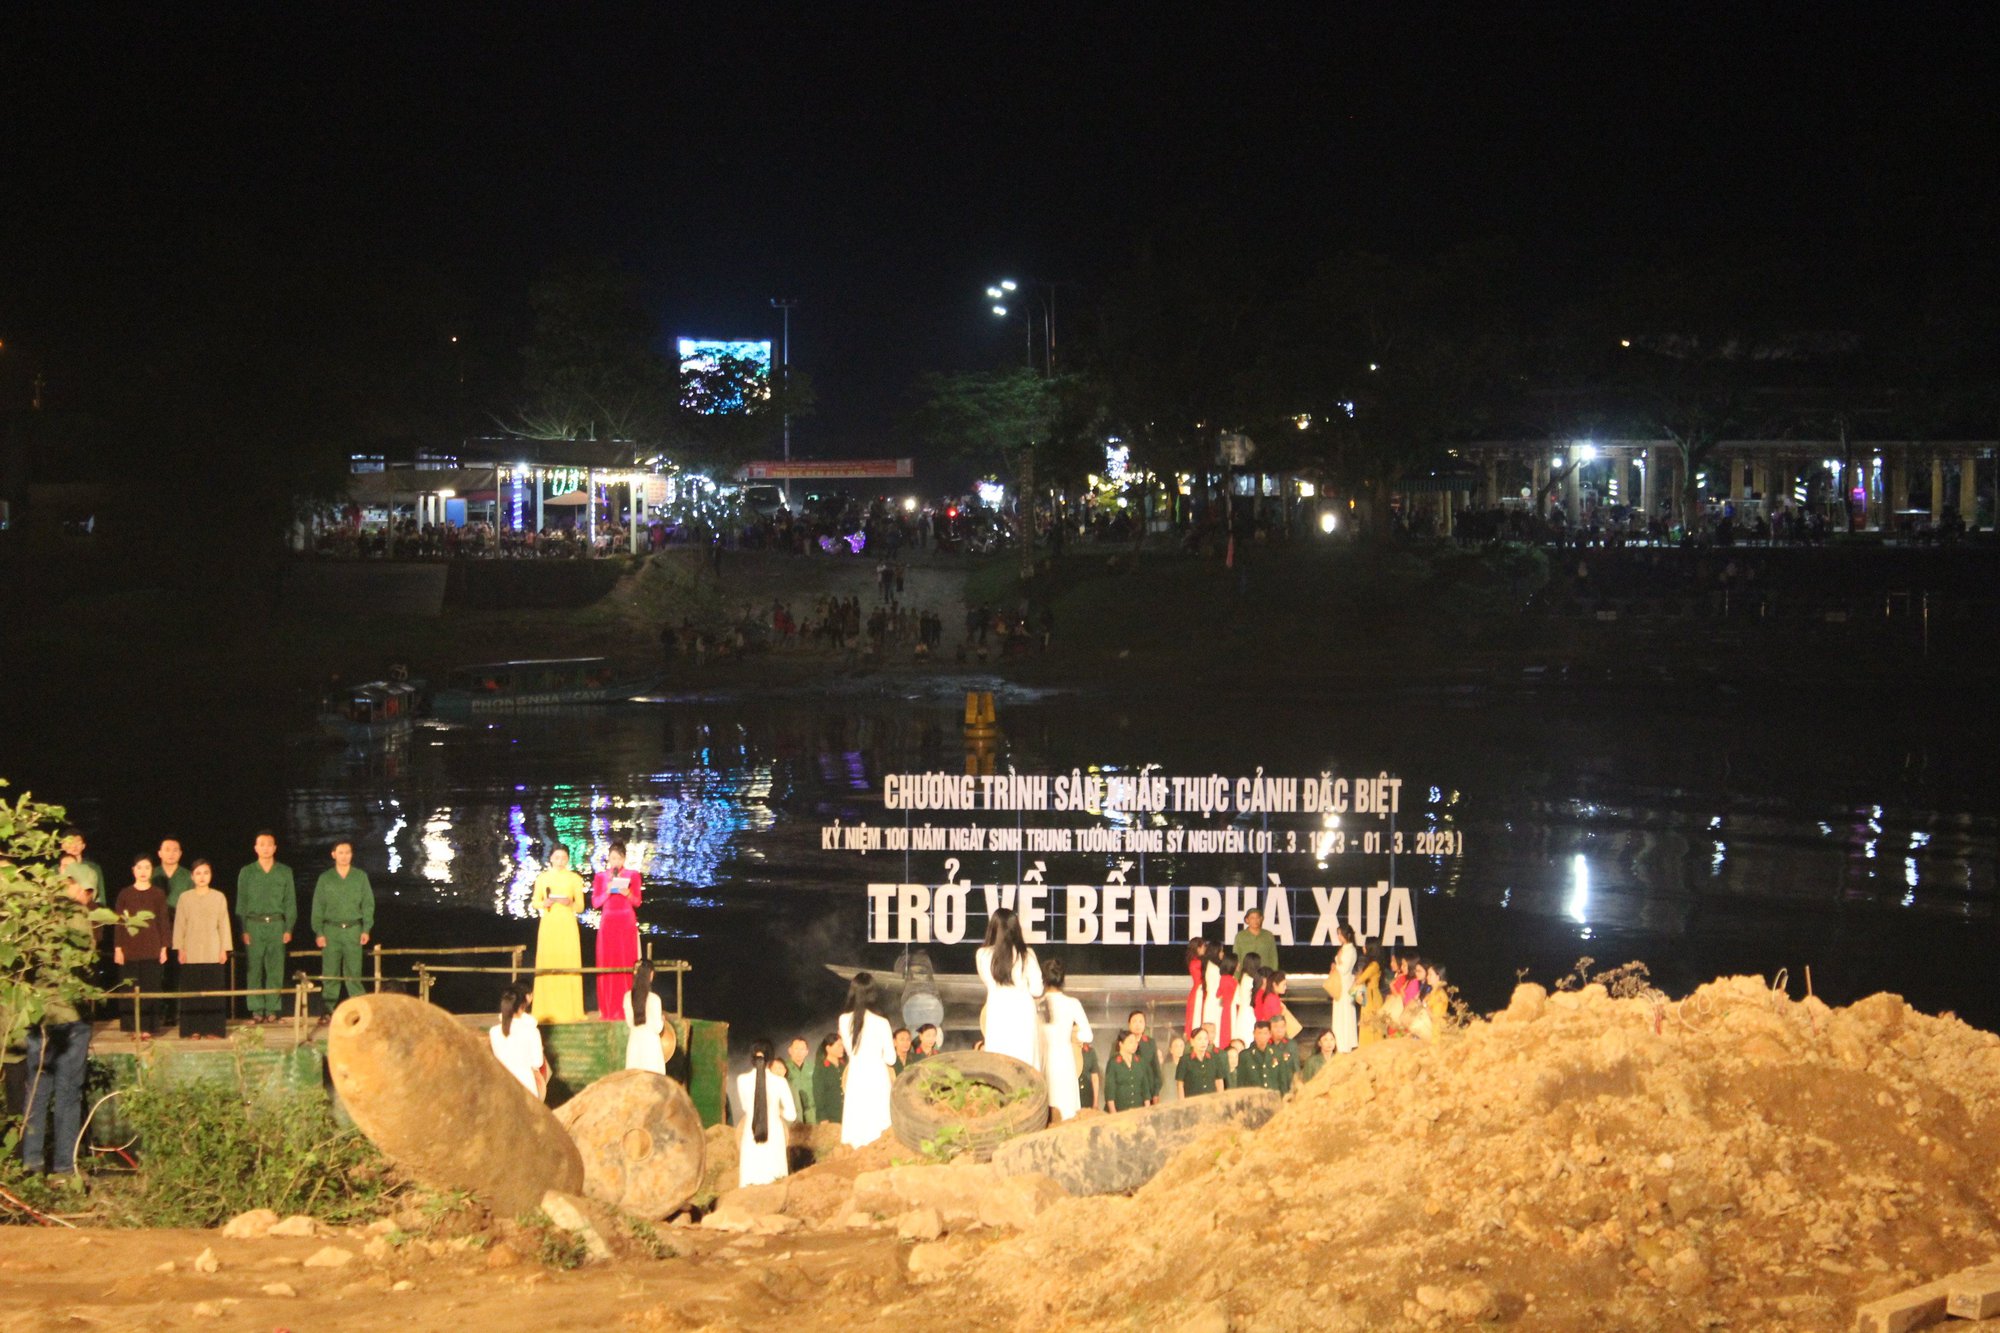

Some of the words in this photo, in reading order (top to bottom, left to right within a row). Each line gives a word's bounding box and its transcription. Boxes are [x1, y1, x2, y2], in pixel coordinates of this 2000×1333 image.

[885, 771, 975, 810] CHƯƠNG
[981, 764, 1048, 810] TRÌNH
[1054, 767, 1101, 811] SÂN
[1172, 773, 1230, 818] THỰC
[1236, 766, 1297, 813] CẢNH
[1303, 771, 1349, 820] ĐẶC
[1355, 770, 1402, 820] BIỆT
[822, 818, 842, 850] KỶ
[845, 821, 881, 855] NIỆM
[884, 828, 909, 850] 100
[912, 822, 945, 851] NĂM
[949, 822, 986, 851] NGÀY
[989, 828, 1022, 852] SINH
[1026, 828, 1072, 852] TRUNG
[1075, 822, 1121, 852] TƯỚNG
[868, 858, 971, 945] TRỞ
[1066, 861, 1171, 945] BẾN
[1189, 873, 1295, 945] PHÀ
[1310, 880, 1418, 946] XƯA
